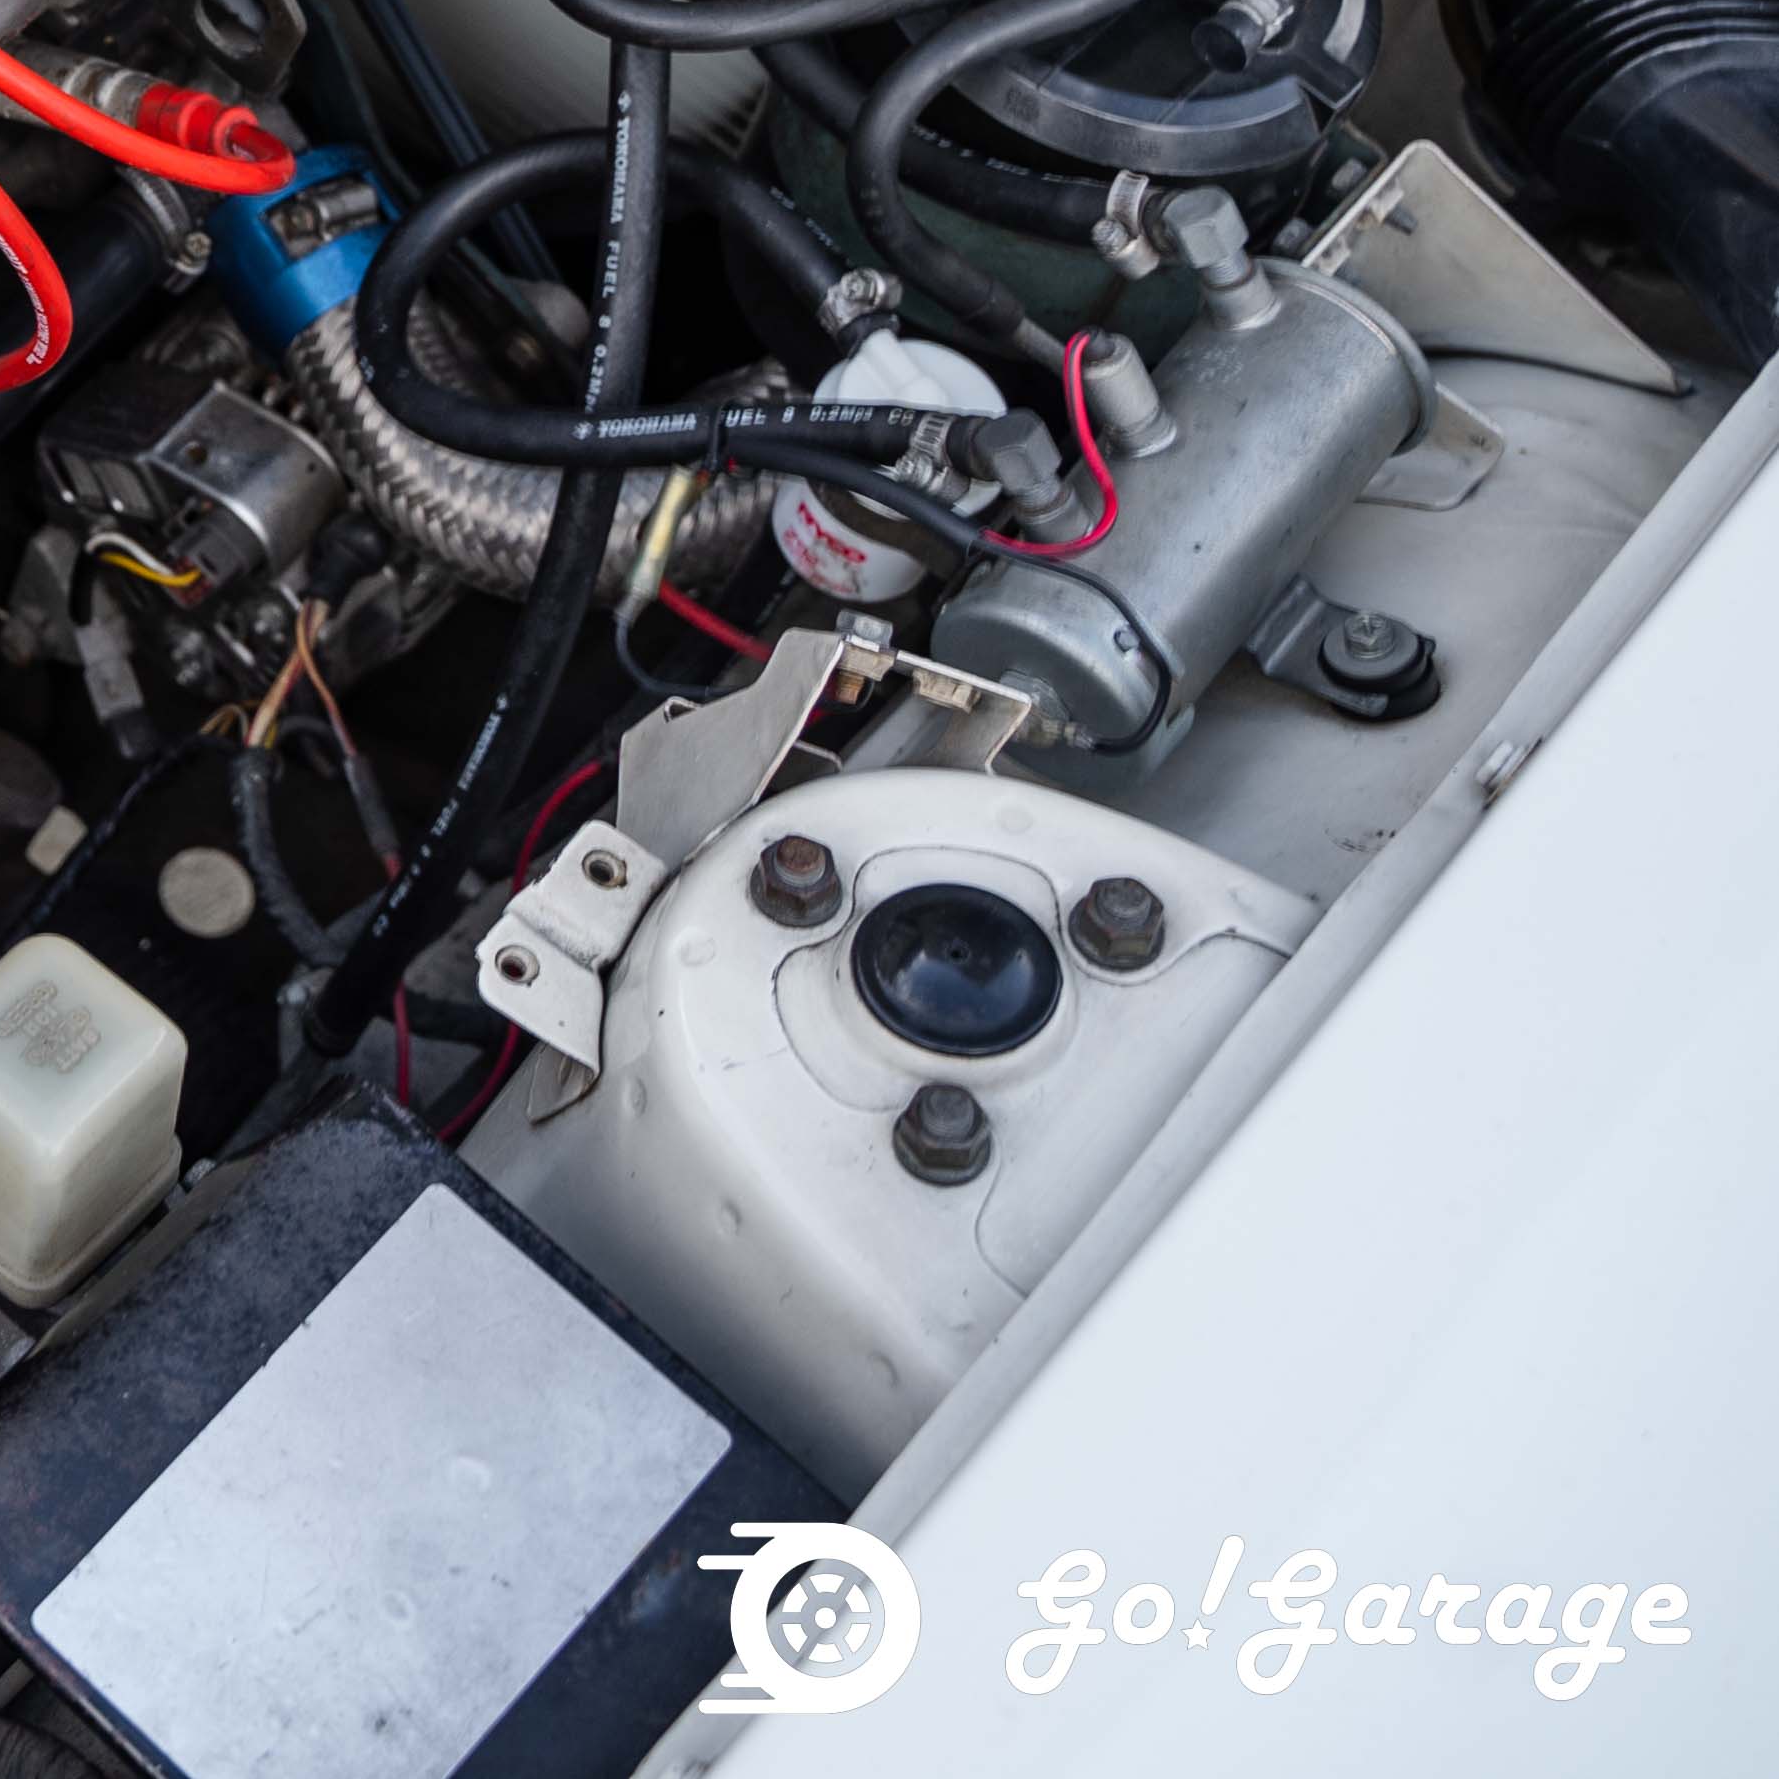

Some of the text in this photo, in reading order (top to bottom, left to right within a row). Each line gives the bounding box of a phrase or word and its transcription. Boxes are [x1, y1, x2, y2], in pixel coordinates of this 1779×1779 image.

[609, 116, 631, 224] YOKOHAMA
[602, 240, 621, 299] FUEL
[597, 314, 612, 329] 8
[597, 412, 698, 439] YOKOHAMA
[722, 407, 768, 429] UEL
